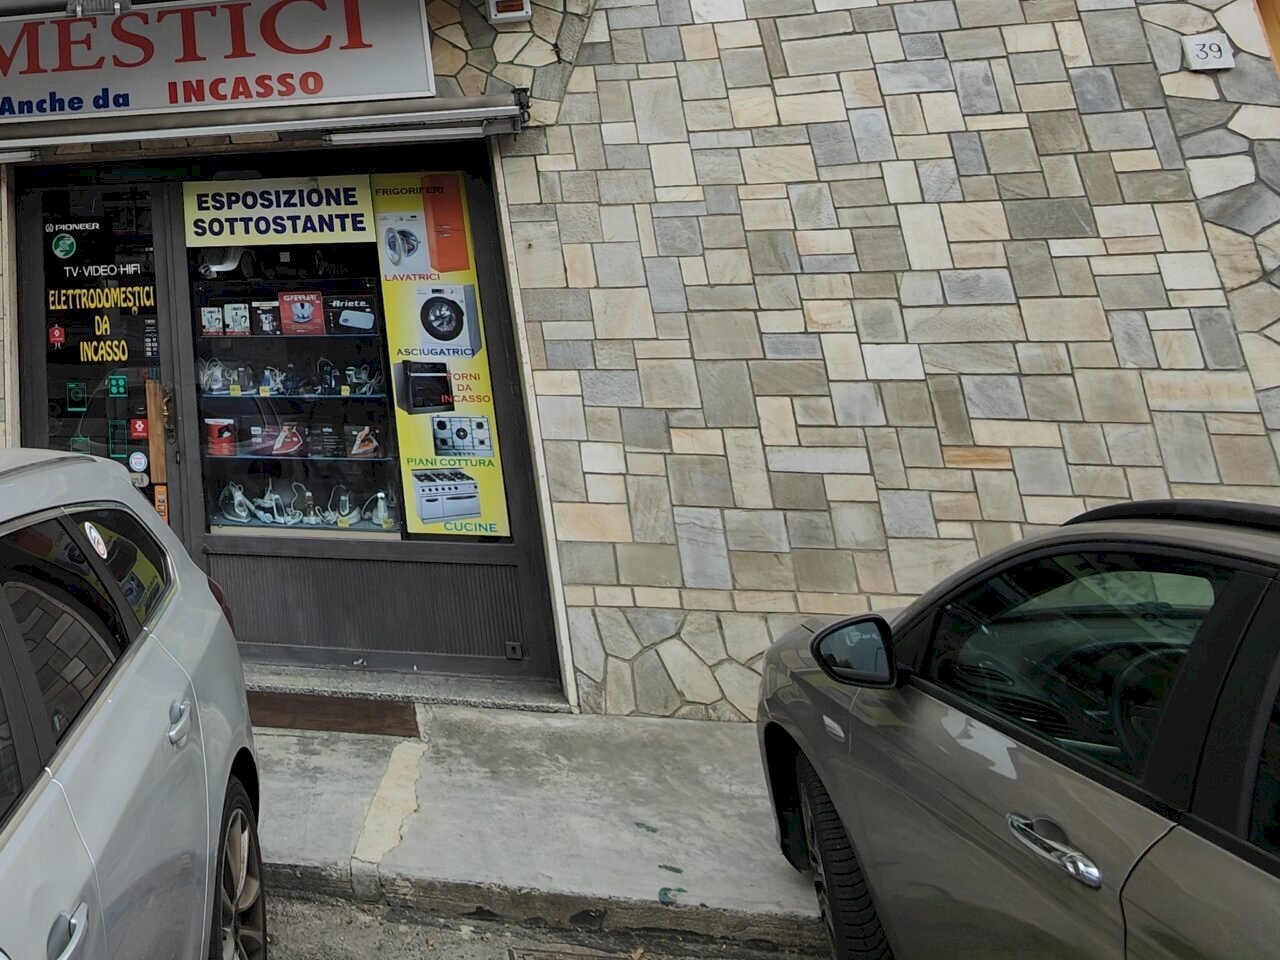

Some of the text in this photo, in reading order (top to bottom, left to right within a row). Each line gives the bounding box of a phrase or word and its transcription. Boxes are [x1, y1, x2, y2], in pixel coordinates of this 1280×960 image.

[1195, 43, 1223, 60] 39
[167, 71, 324, 104] INCASSO
[93, 87, 131, 109] da
[375, 186, 444, 196] FRIGORIFERI
[196, 186, 358, 211] ESPOSIZIONE
[55, 223, 100, 232] PIONEER
[193, 212, 366, 237] SOTTOSTANTE
[384, 273, 441, 282] LAVATRICI
[49, 285, 155, 310] ELETTRODOMESTICI
[94, 315, 111, 336] DA
[79, 339, 129, 362] INCASSO
[396, 348, 474, 356] ASCIUGATRICI
[446, 372, 481, 381] FORNI
[457, 384, 473, 392] DA
[441, 394, 491, 403] INCASSO
[407, 457, 495, 467] PIANI COTTURA
[444, 521, 499, 533] CUCINE
